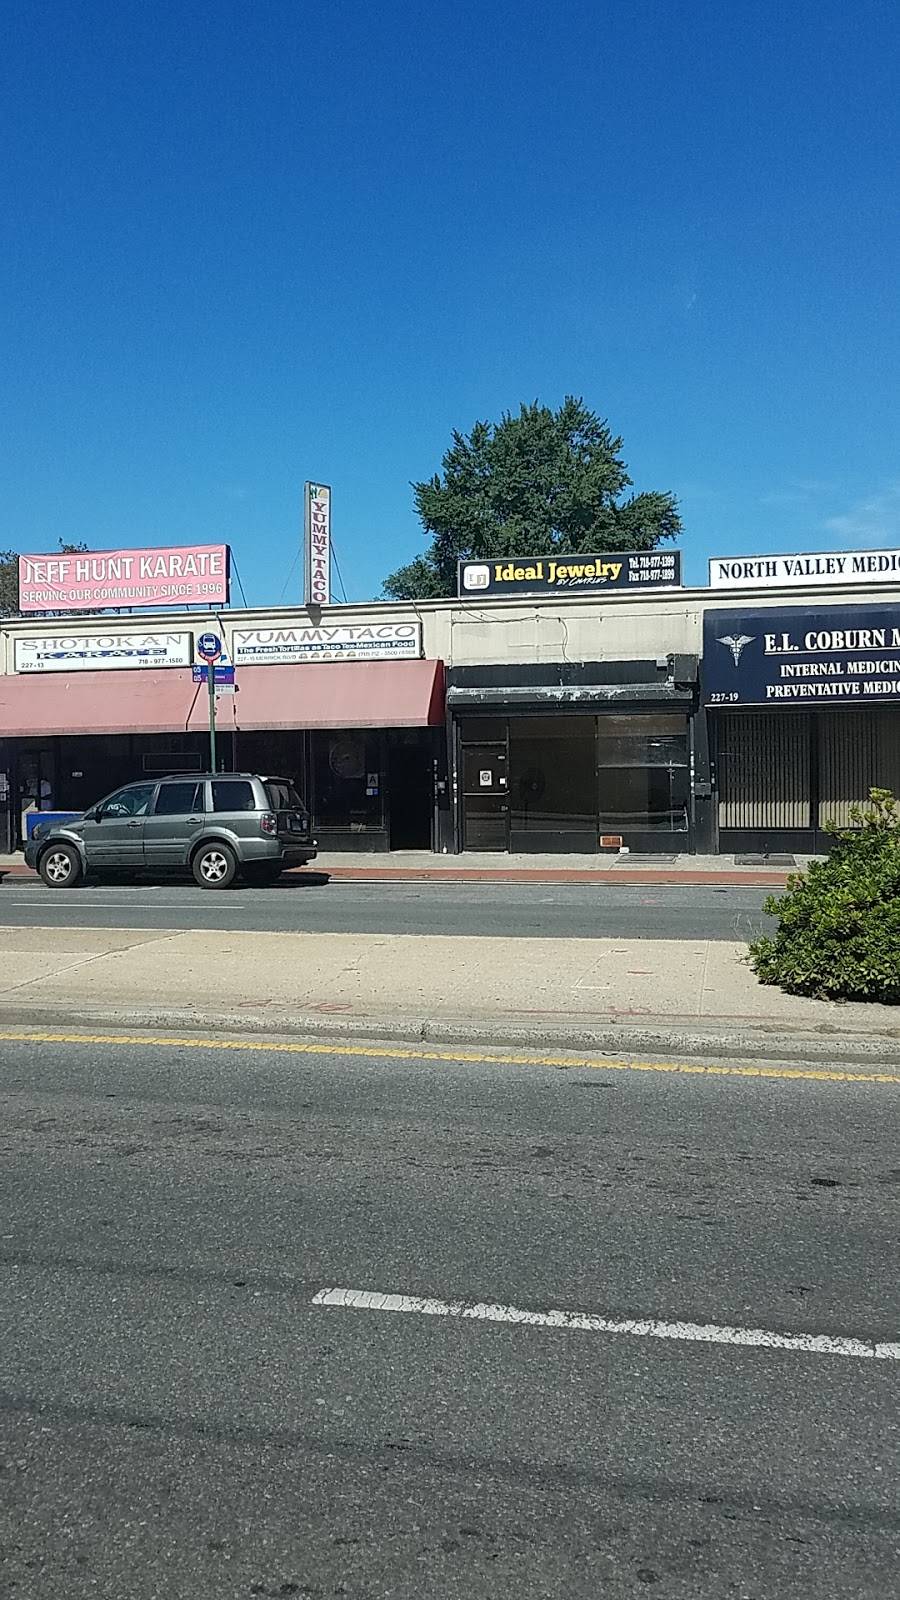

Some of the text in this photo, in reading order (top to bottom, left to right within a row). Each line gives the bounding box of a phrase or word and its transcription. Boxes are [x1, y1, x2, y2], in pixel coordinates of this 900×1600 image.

[312, 501, 327, 556] YUMMY
[23, 552, 223, 584] JEFF HUNT KARATE
[495, 562, 544, 582] Ideal
[548, 559, 622, 584] Jewelry
[628, 570, 639, 581] Fax
[718, 554, 900, 579] NORTH VALLEY MEDI
[313, 558, 327, 602] TACO
[22, 583, 222, 602] SERVING OUR COMMUNITY SINCE 1996
[238, 625, 416, 644] YUMMY TACO
[764, 633, 799, 651] E.L.
[804, 629, 886, 651] COBURN
[38, 648, 167, 659] KARATE
[277, 644, 310, 653] Tortillas
[321, 643, 341, 651] Taco
[341, 641, 391, 650] Tex-Mexican
[392, 640, 414, 648] Food
[780, 664, 844, 677] INTERNAL
[711, 692, 739, 702] 227-19
[766, 682, 860, 698] PREVENTATIVE
